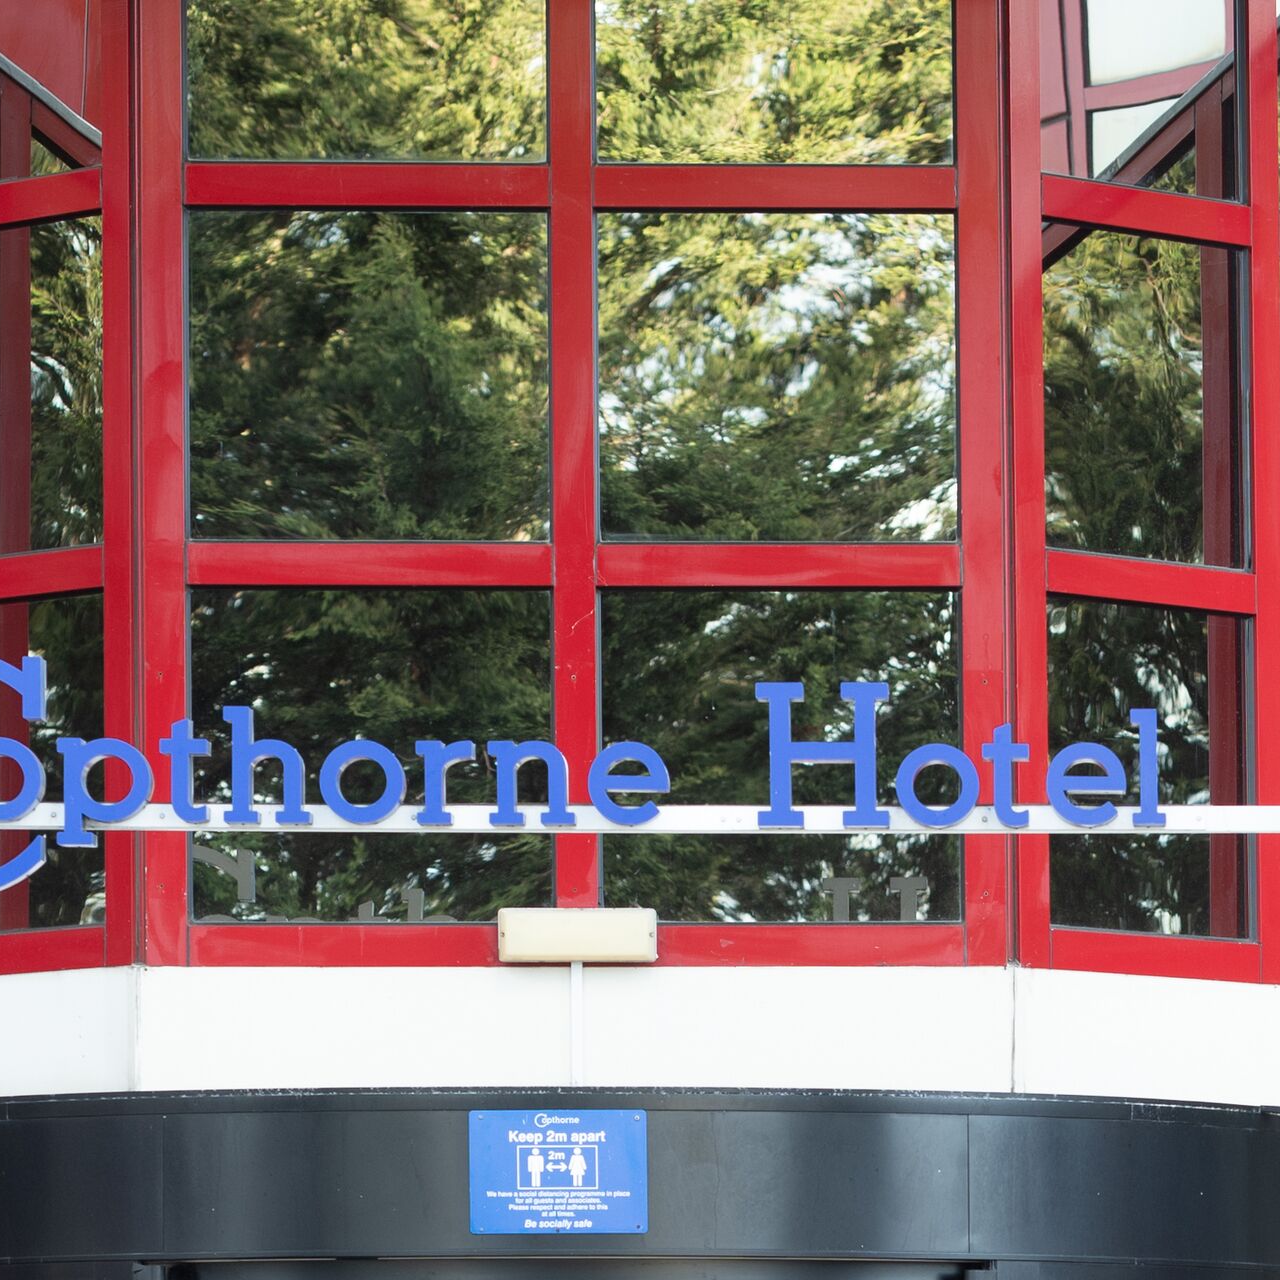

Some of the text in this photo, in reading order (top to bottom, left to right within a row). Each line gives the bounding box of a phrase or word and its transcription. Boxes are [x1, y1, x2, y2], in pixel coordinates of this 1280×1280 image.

[755, 681, 1168, 829] Hotel
[534, 1113, 580, 1128] Copthorne
[508, 1130, 606, 1145] Keep 2m apart
[548, 1151, 565, 1160] 2m
[538, 1191, 569, 1199] distancing
[570, 1191, 605, 1199] programme
[613, 1191, 630, 1199] place
[530, 1204, 553, 1212] respect
[524, 1219, 592, 1230] Be socially safe
